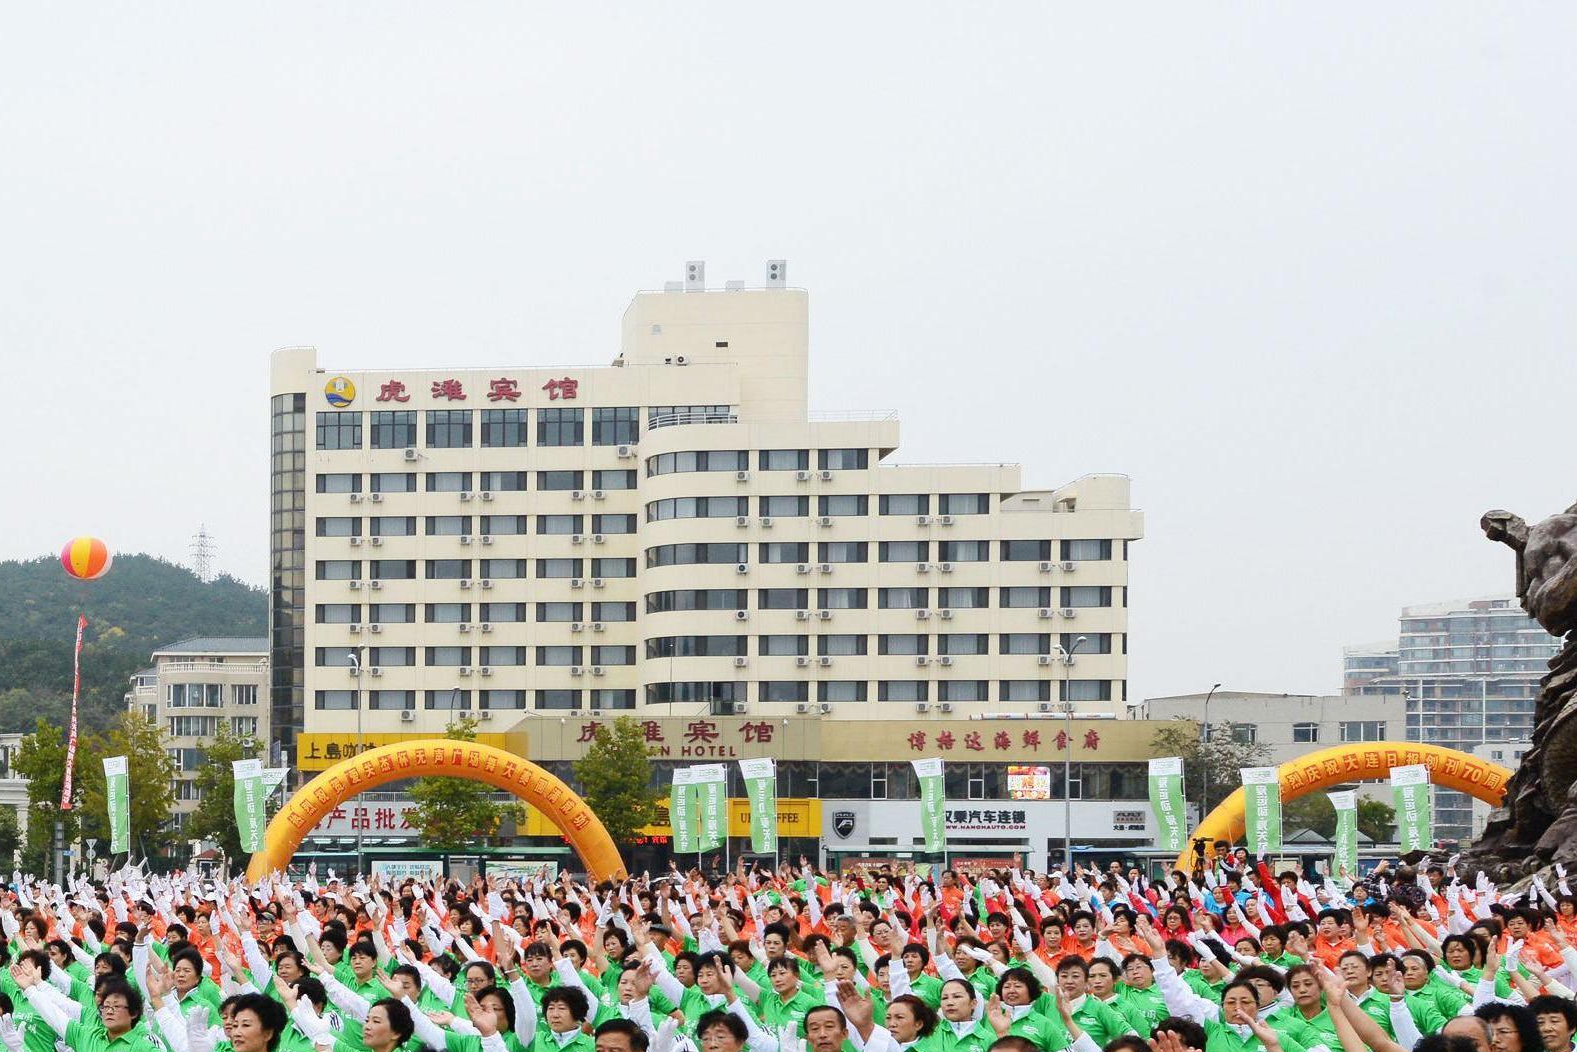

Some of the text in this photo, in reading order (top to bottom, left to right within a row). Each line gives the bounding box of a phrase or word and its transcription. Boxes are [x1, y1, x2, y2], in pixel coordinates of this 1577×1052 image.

[375, 377, 580, 403] 虎滩宾馆
[681, 745, 736, 757] HOTEL
